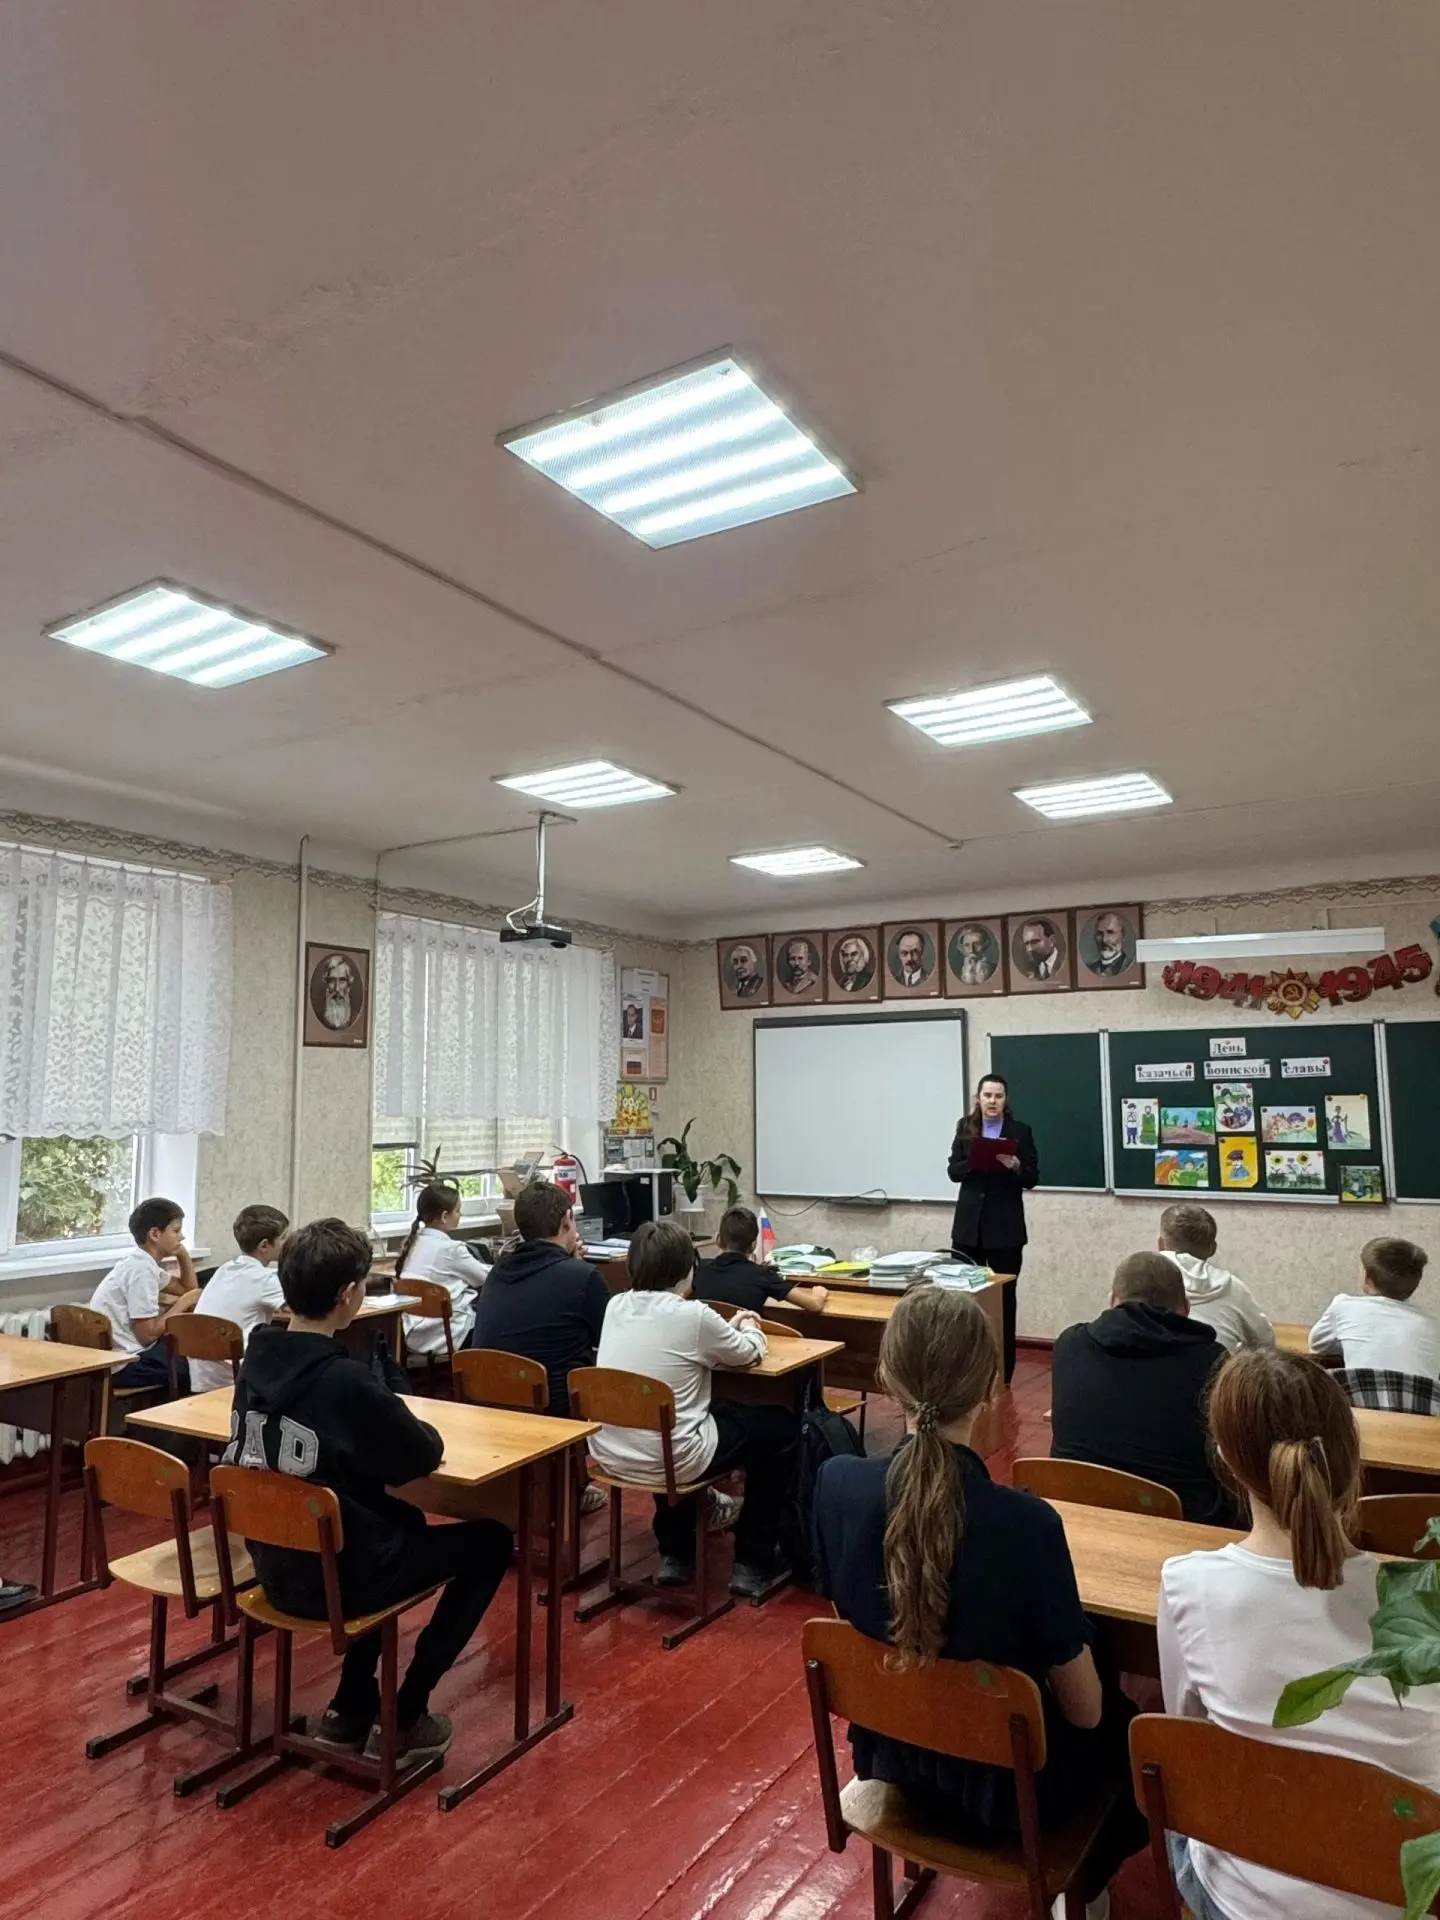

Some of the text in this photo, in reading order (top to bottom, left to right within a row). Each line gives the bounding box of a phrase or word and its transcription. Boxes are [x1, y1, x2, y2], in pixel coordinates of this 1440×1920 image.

[1167, 944, 1433, 1010] 1941 1945
[1213, 1043, 1244, 1055] День
[1138, 1065, 1326, 1078] казачьей воинской славы
